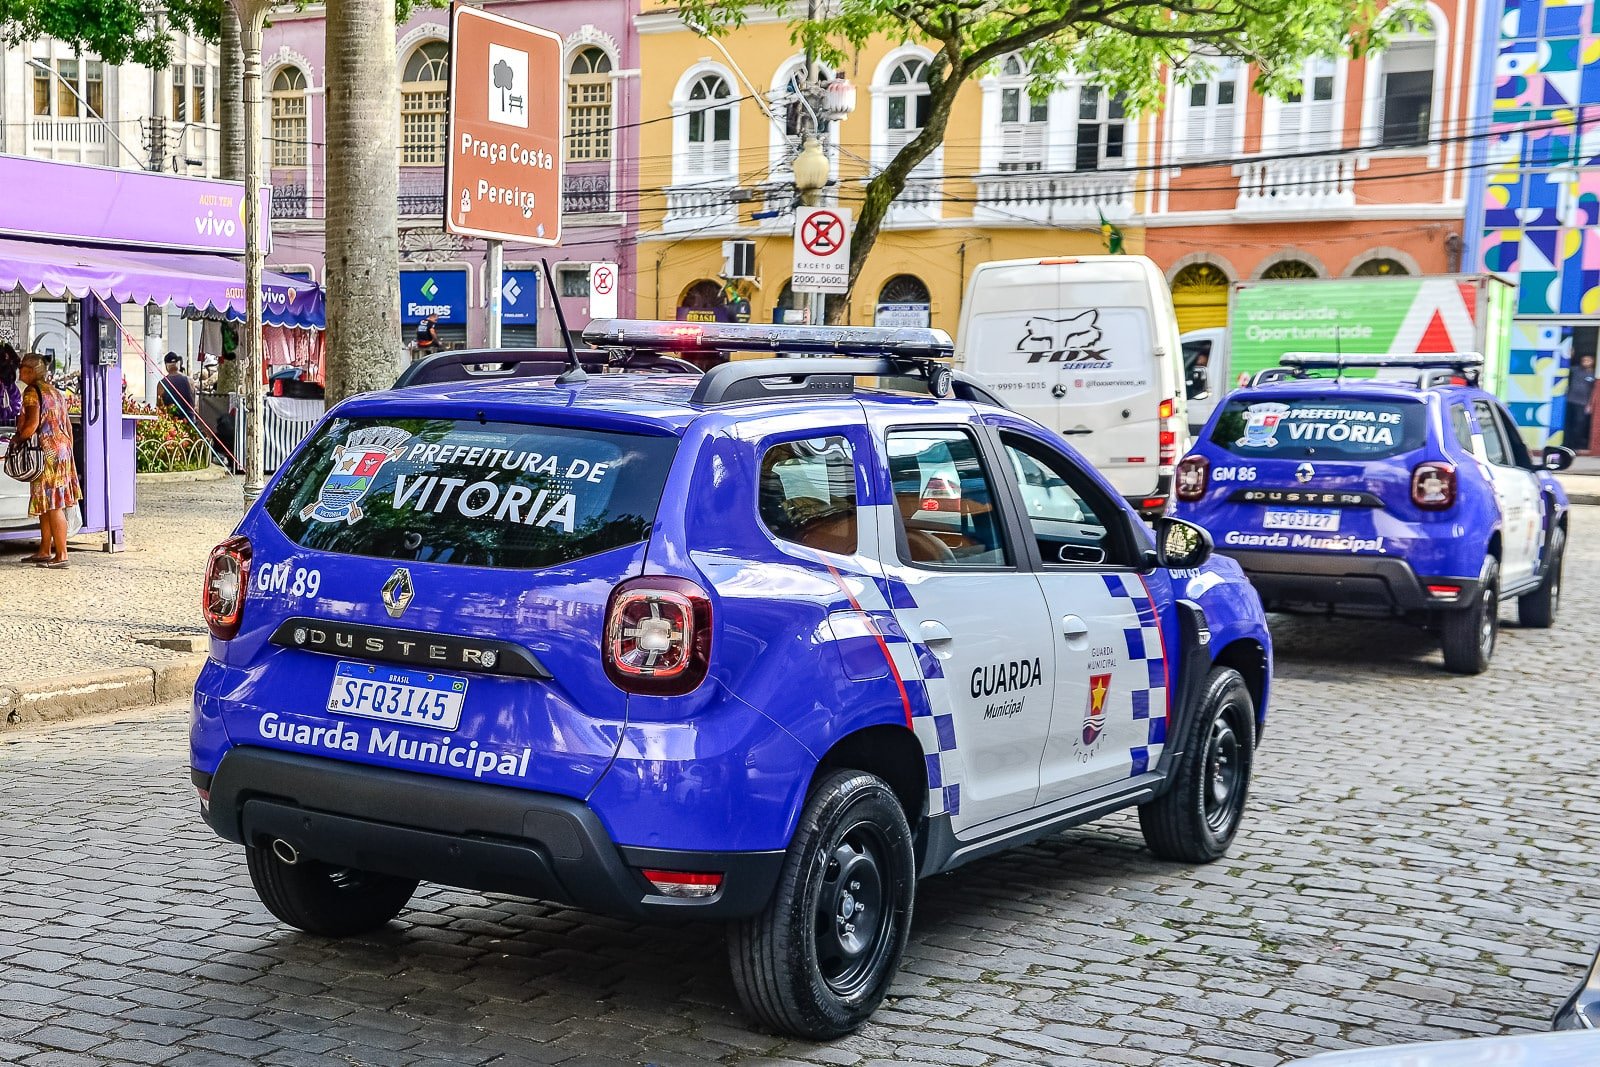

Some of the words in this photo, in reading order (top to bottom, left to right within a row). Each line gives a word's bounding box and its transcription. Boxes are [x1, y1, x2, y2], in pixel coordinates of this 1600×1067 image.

[461, 132, 507, 165] Praça
[510, 142, 553, 170] Costa
[199, 195, 217, 206] AQUI
[219, 196, 233, 207] TEM
[477, 179, 535, 209] Pereira
[195, 210, 236, 237] vivo
[225, 288, 244, 299] AQUI
[261, 287, 286, 304] vivo
[1245, 323, 1373, 343] Oportunidade
[1012, 348, 1112, 364] FOX
[1062, 361, 1114, 369] SERVICES
[1290, 409, 1376, 422] PREFEITURA
[1378, 413, 1401, 425] DE
[1288, 420, 1393, 446] VITÓRIA
[407, 443, 558, 474] PREFEITURA
[565, 459, 609, 483] DE
[1212, 467, 1236, 481] GM
[1237, 467, 1257, 481] 86
[392, 471, 577, 533] VITÓRIA
[1254, 492, 1354, 503] DUSTER
[1225, 531, 1288, 547] Guarda
[1291, 533, 1384, 552] Municipal
[257, 563, 290, 594] GM
[292, 567, 321, 599] 89
[311, 629, 482, 664] DUSTER
[1091, 646, 1114, 658] GUARDA
[1087, 659, 1117, 670] MUNICIPAL
[389, 674, 410, 684] BRASIL
[970, 657, 1042, 699] GUARDA
[330, 699, 339, 709] BR
[342, 681, 448, 720] SFQ3I45
[984, 695, 1026, 720] Municipal
[259, 712, 360, 751] Guarda
[367, 727, 531, 777] Municipal
